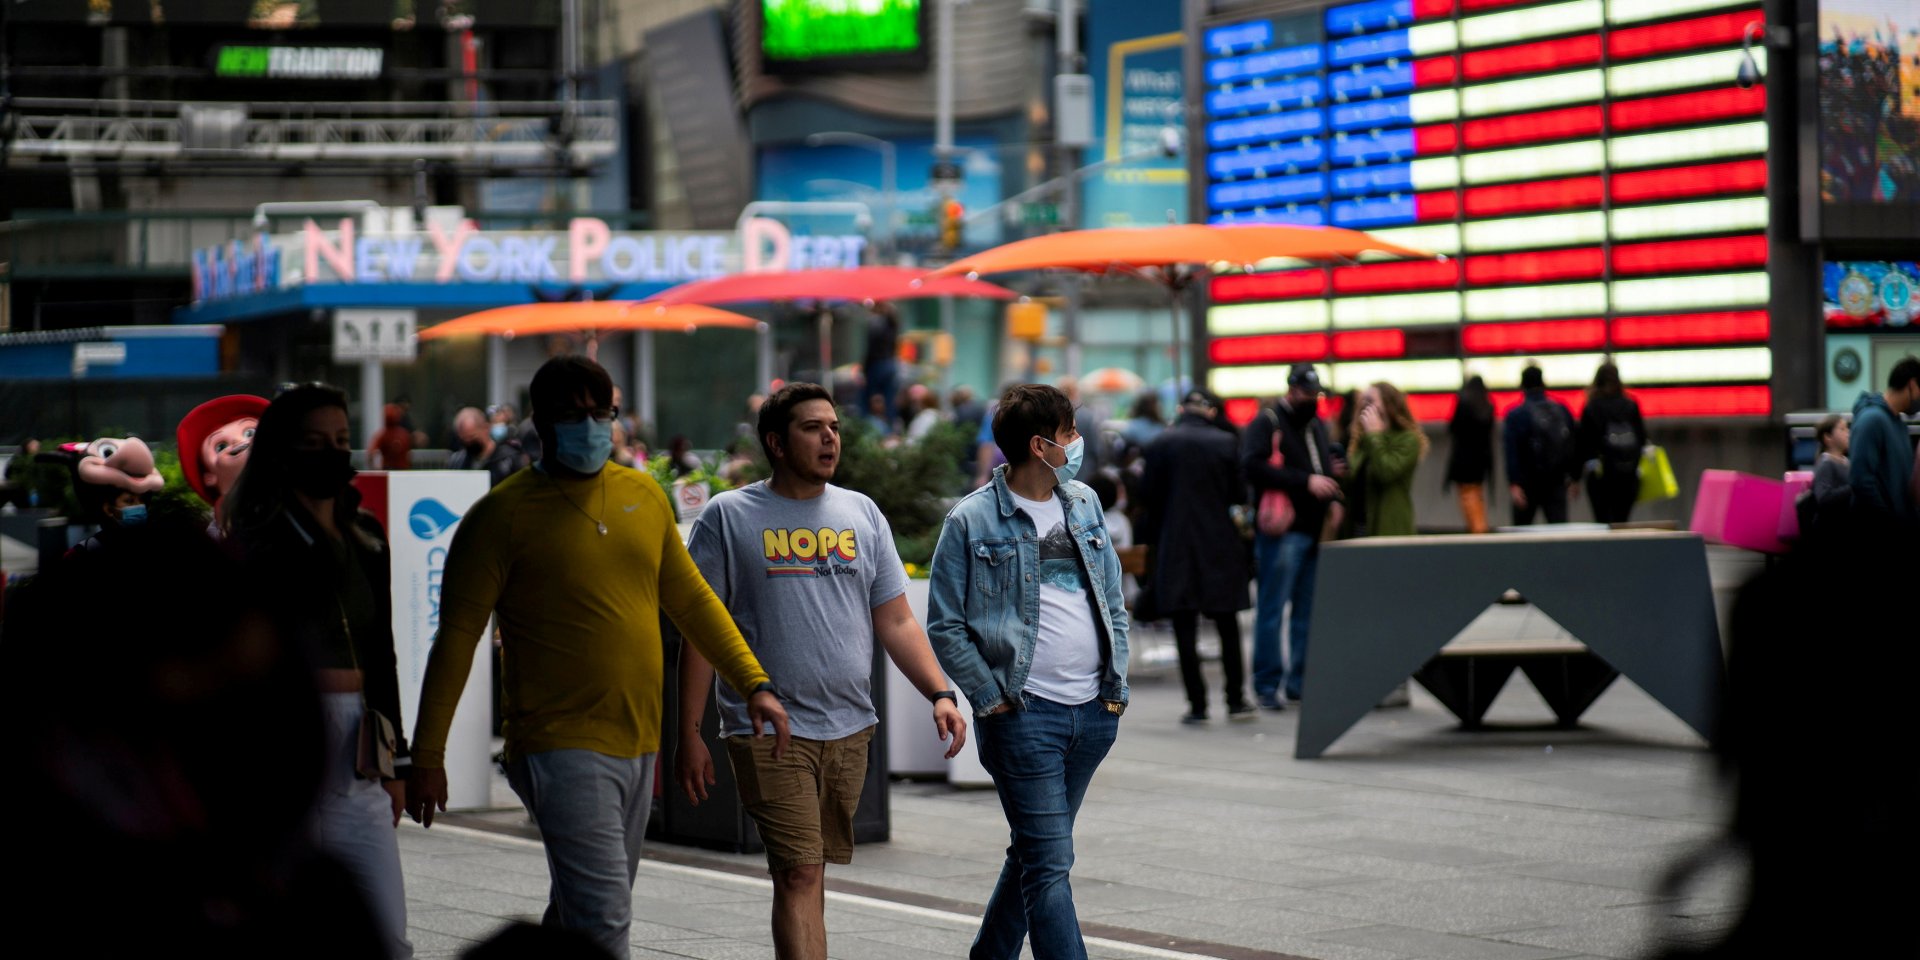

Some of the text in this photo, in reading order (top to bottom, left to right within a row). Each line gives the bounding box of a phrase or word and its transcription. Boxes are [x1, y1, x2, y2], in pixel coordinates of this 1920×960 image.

[304, 218, 422, 284] NEW
[427, 218, 561, 284] YORK
[569, 217, 728, 282] POLICE
[763, 527, 857, 564] NOPE
[814, 564, 858, 578] Not Today
